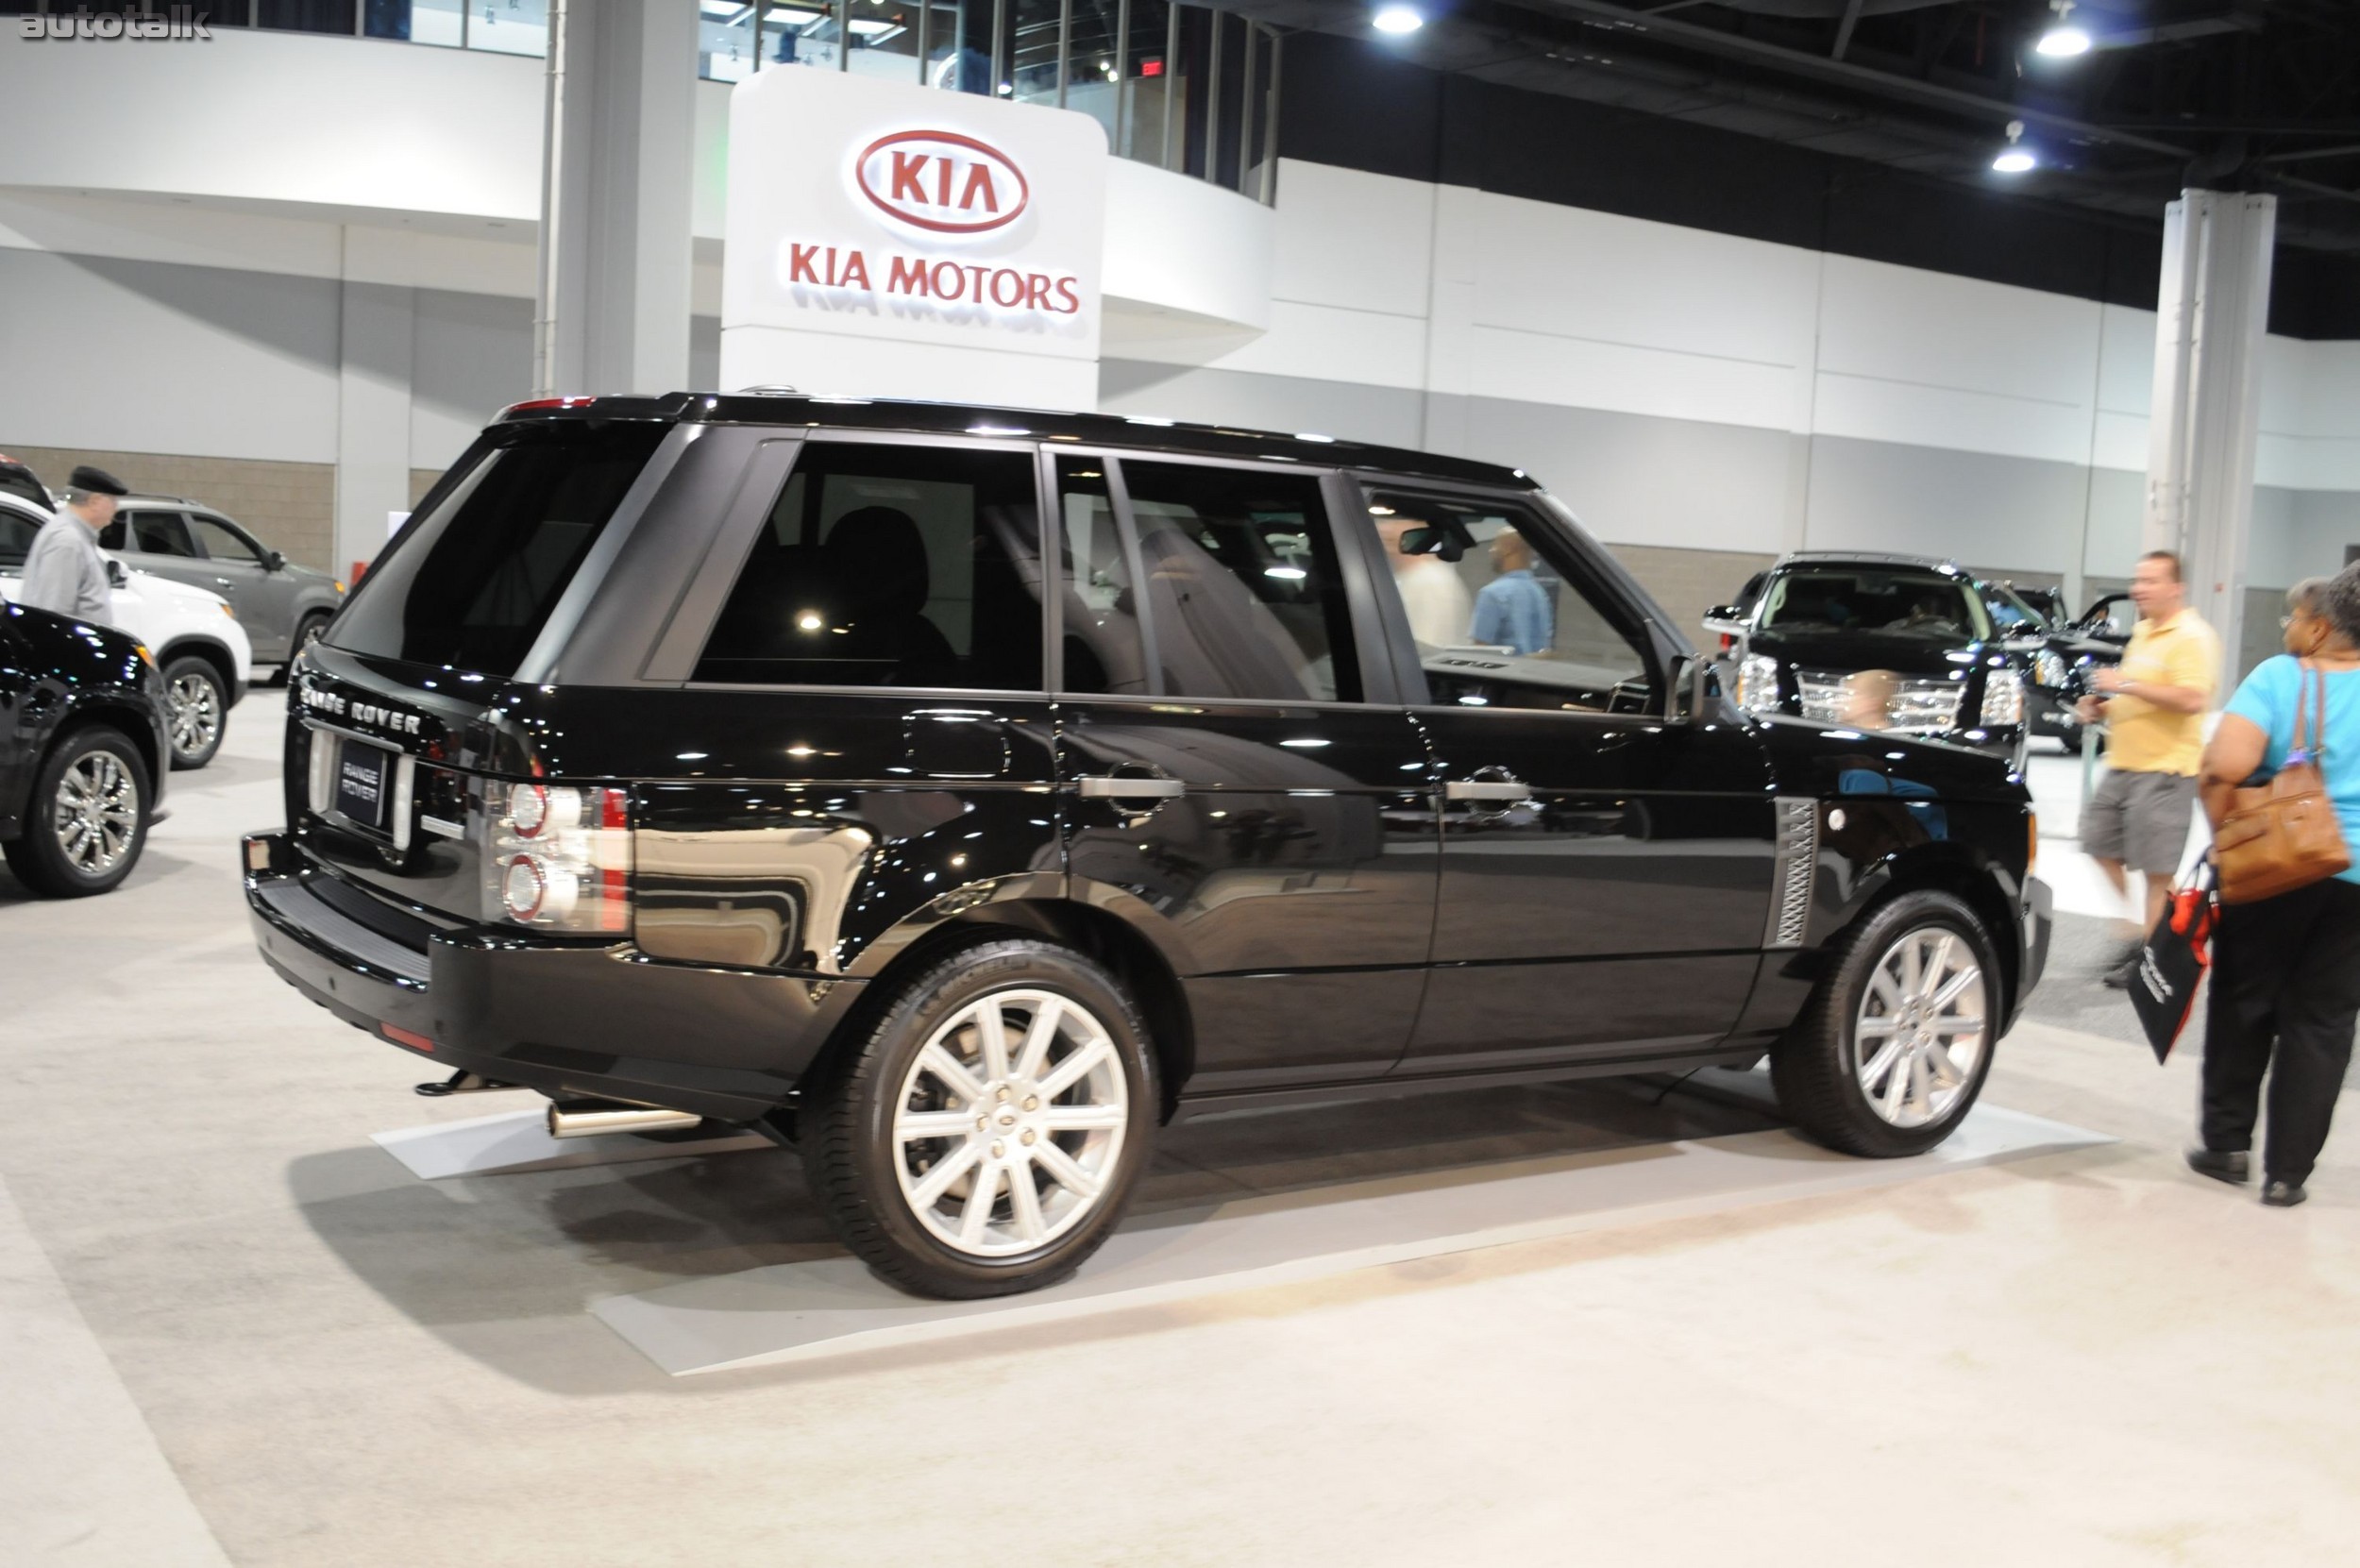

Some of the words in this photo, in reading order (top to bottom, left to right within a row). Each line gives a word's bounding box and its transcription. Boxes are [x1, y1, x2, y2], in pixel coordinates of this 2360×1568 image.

[891, 150, 999, 213] KIA
[789, 243, 871, 291] KIA
[886, 256, 1079, 314] MOTORS
[351, 701, 421, 735] ROVER
[343, 761, 379, 784] RANGE
[342, 778, 378, 802] ROVER
